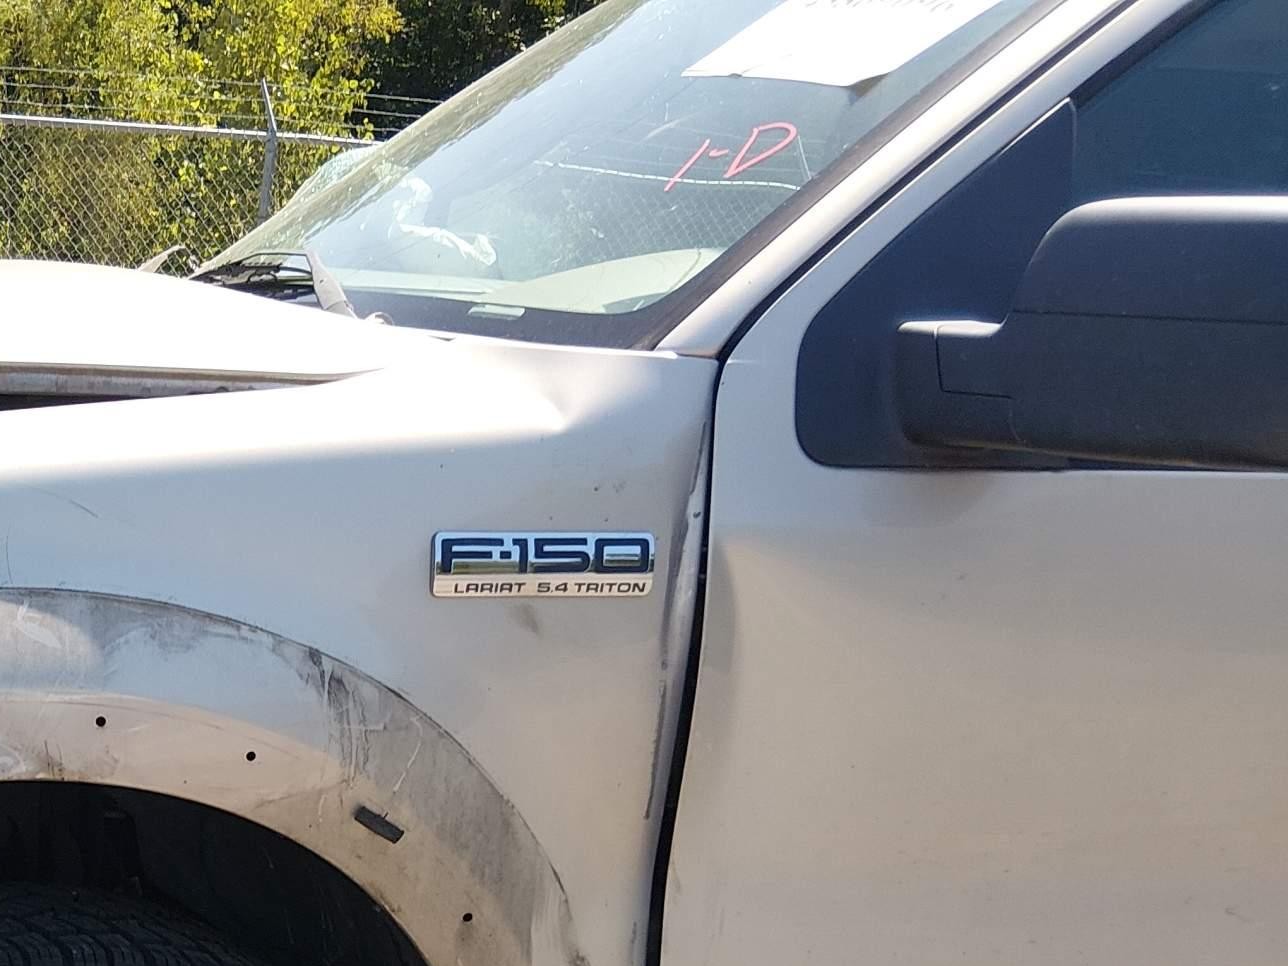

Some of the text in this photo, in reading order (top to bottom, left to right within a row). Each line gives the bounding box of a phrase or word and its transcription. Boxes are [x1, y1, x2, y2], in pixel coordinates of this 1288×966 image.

[440, 537, 650, 574] F-150
[453, 581, 647, 594] LARIAT 5.4 TRITON
